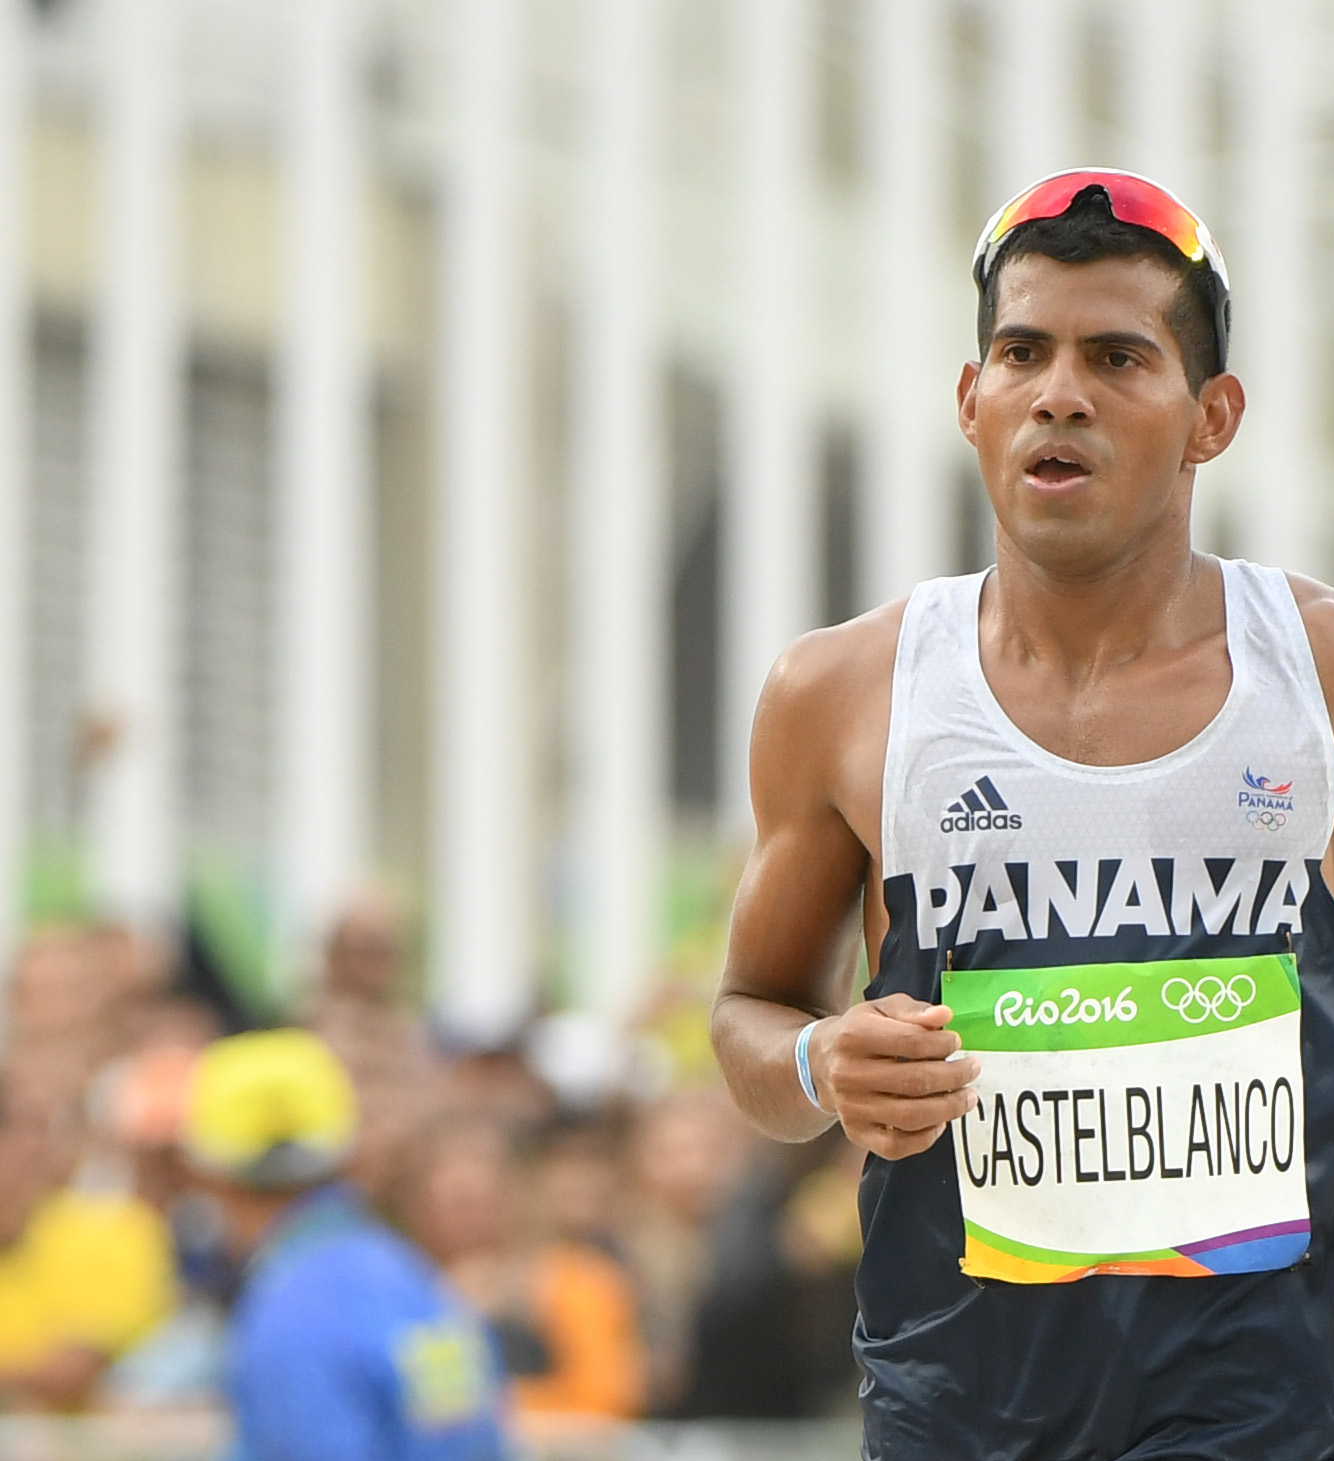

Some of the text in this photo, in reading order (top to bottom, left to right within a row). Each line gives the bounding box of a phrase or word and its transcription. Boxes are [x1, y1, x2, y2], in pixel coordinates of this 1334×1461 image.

[940, 811, 1022, 833] adidas
[912, 857, 1310, 950] PANAMA
[961, 1076, 1294, 1188] CASTELBLANCO
